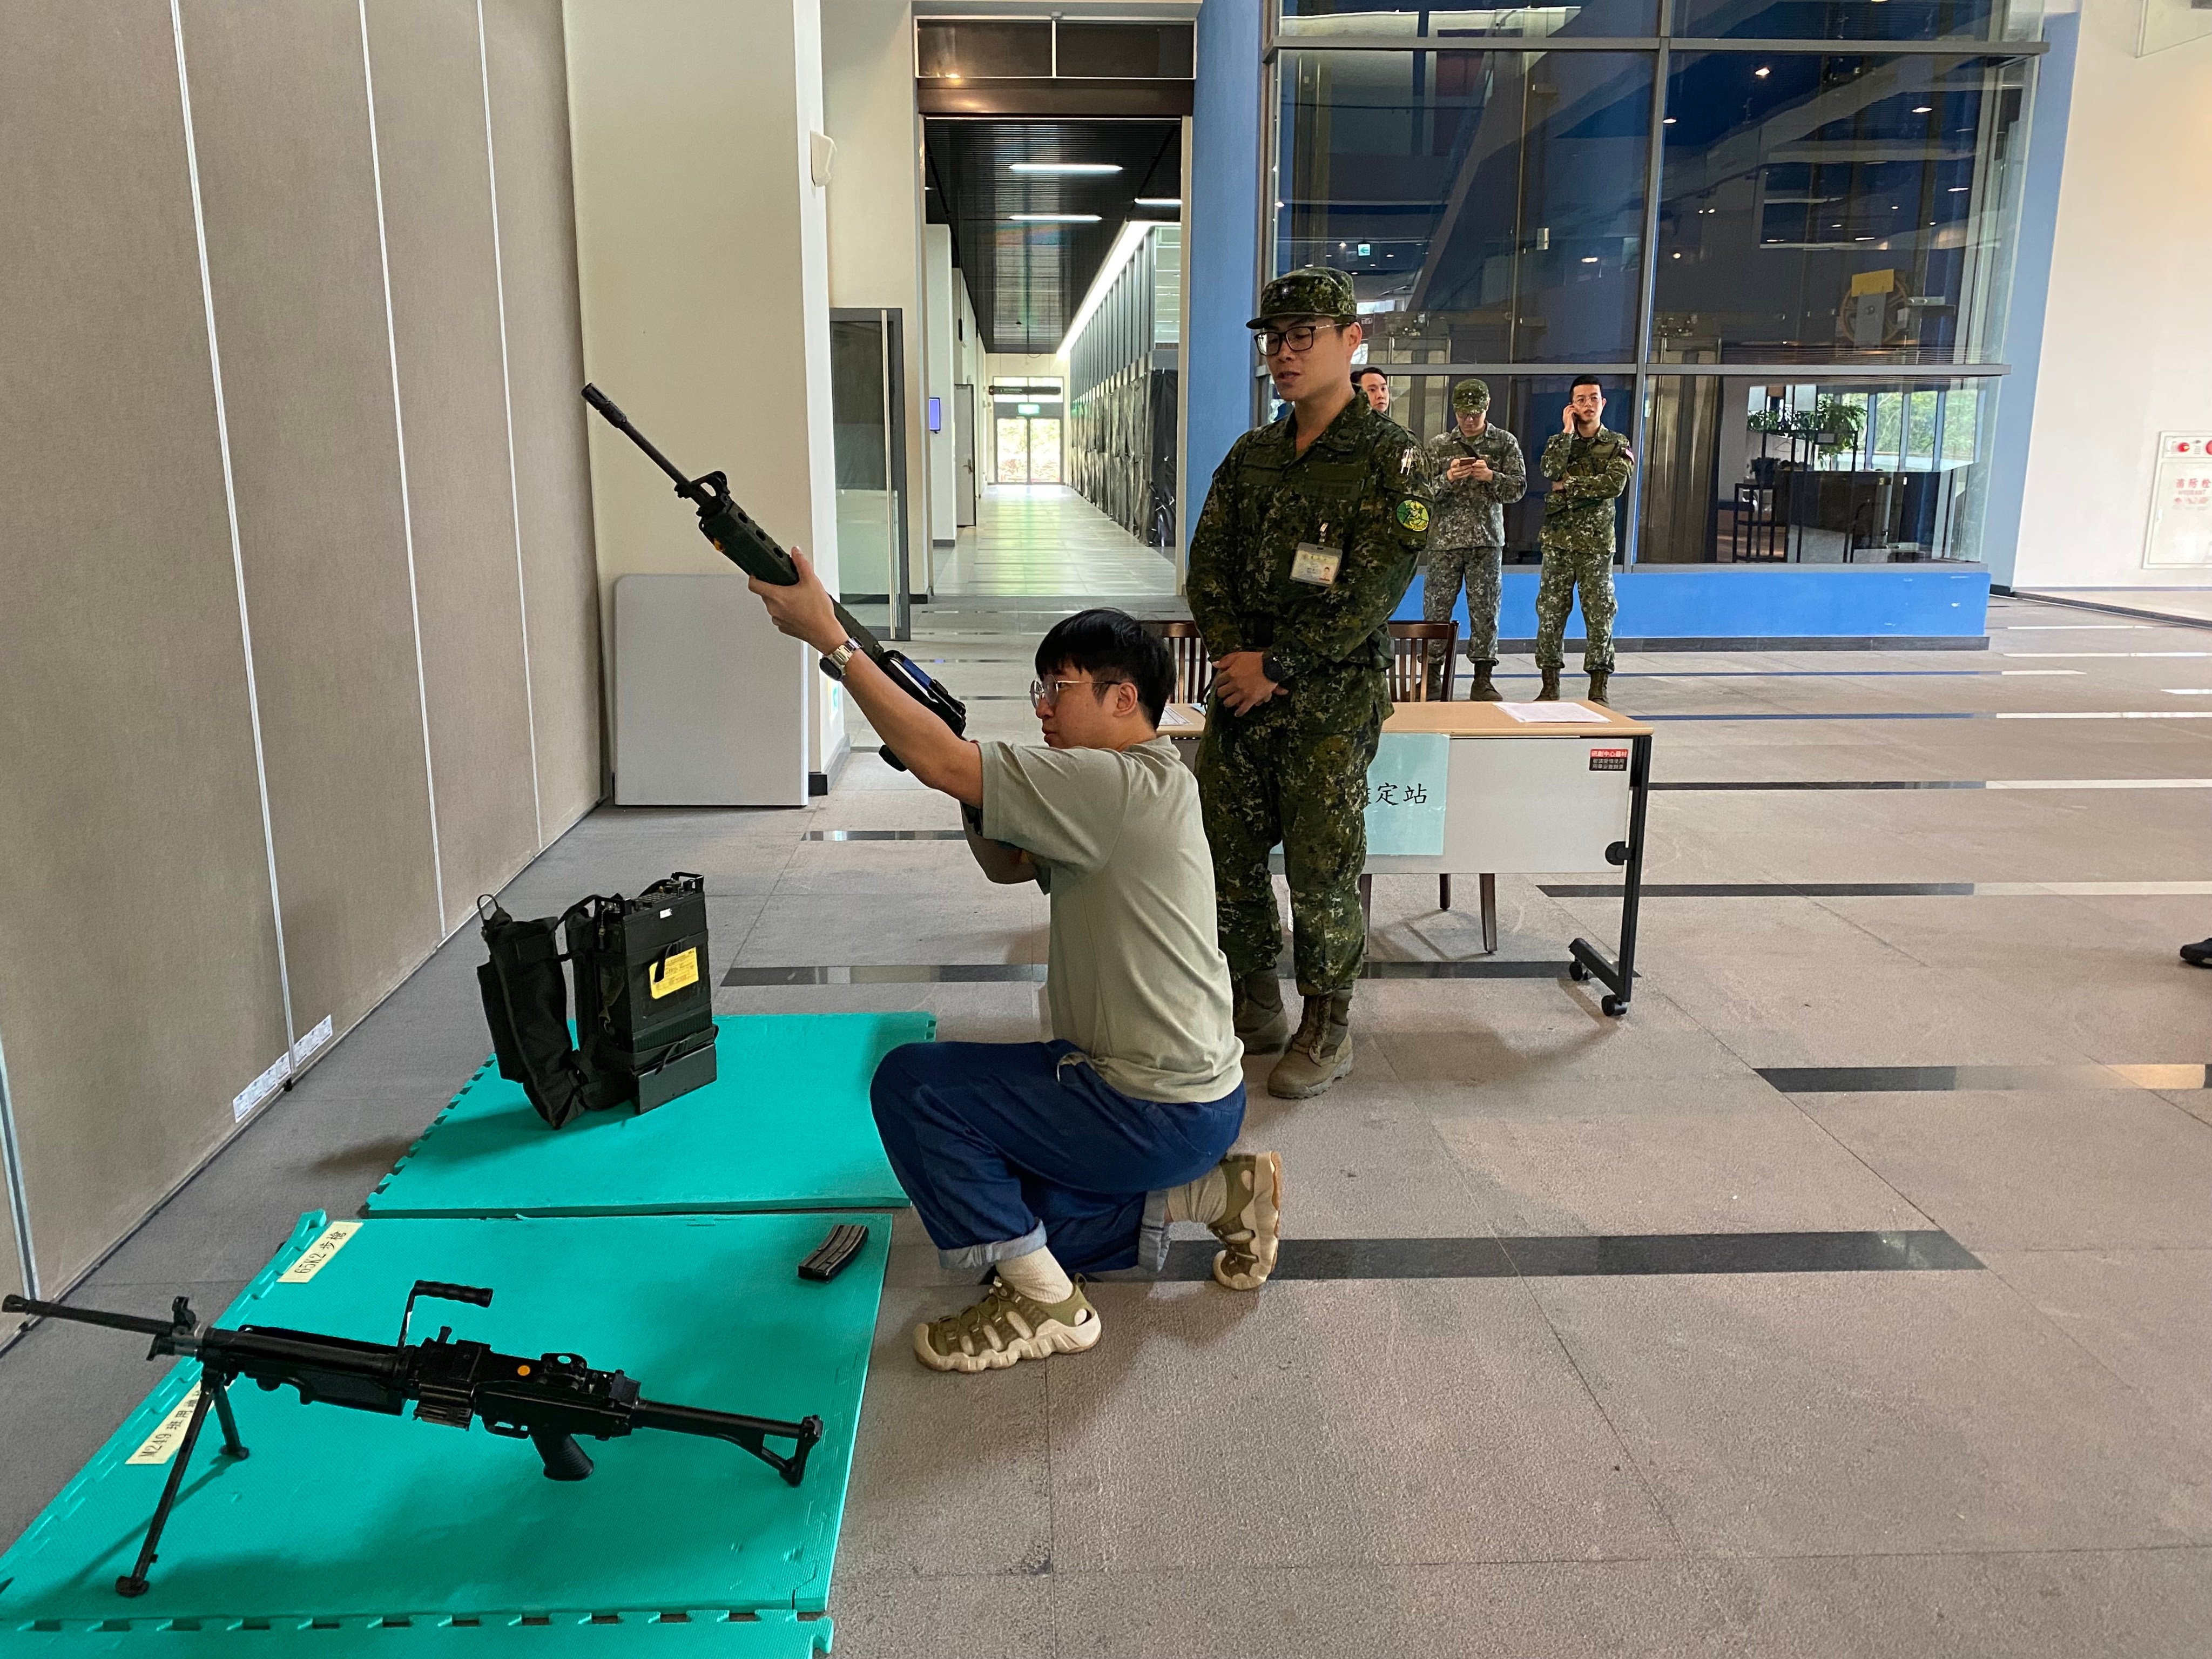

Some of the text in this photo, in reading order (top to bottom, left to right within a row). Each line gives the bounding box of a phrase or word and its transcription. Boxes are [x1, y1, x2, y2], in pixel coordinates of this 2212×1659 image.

[1367, 783, 1427, 806] 定站
[294, 1231, 347, 1273] 65K2 步槍
[138, 1433, 172, 1458] M249
